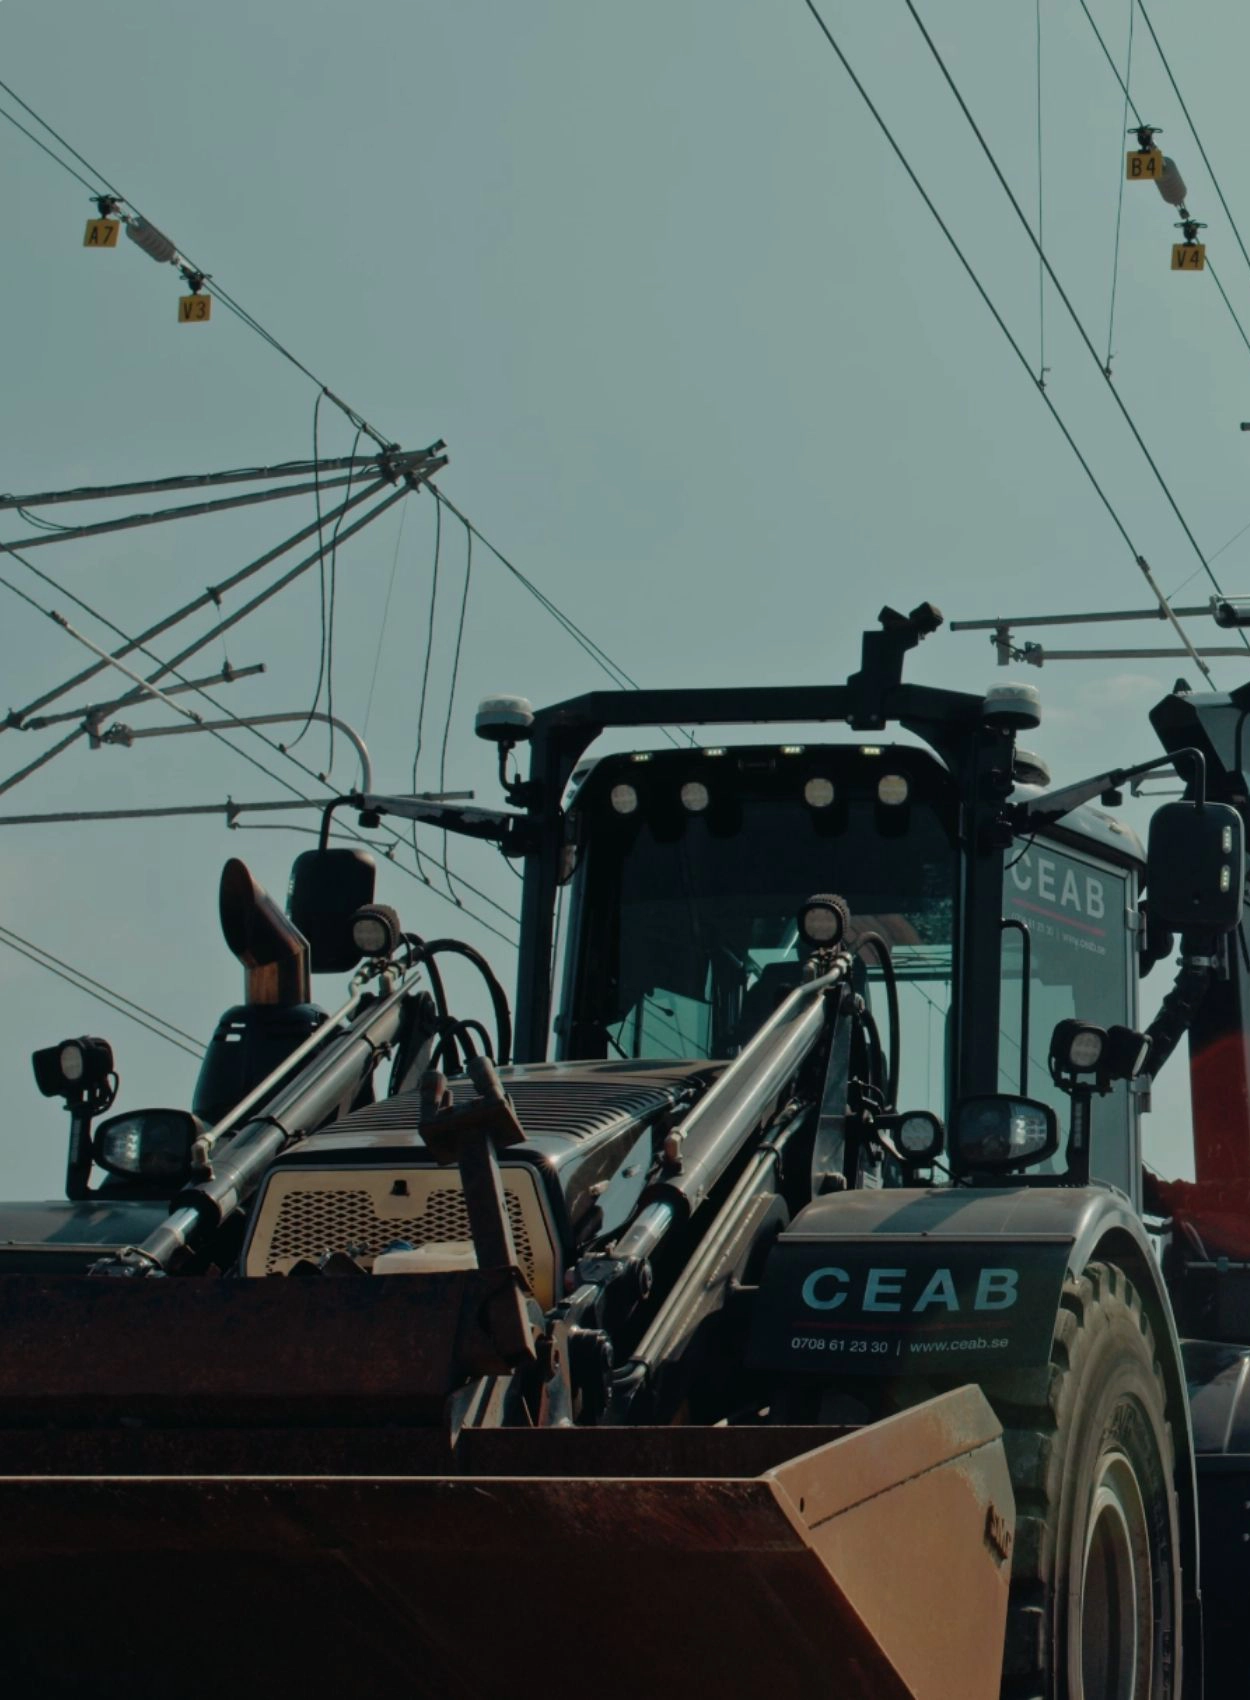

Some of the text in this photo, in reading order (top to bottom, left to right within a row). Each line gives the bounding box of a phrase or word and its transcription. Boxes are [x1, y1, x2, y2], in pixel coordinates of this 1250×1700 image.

[1131, 157, 1157, 177] B4
[88, 225, 115, 245] A7
[1177, 250, 1200, 268] V4
[183, 302, 207, 320] V3
[1010, 848, 1106, 920] CEAB
[801, 1266, 1020, 1312] CEAB
[791, 1336, 1009, 1354] 0708 61 23 30 www.ceab.se
